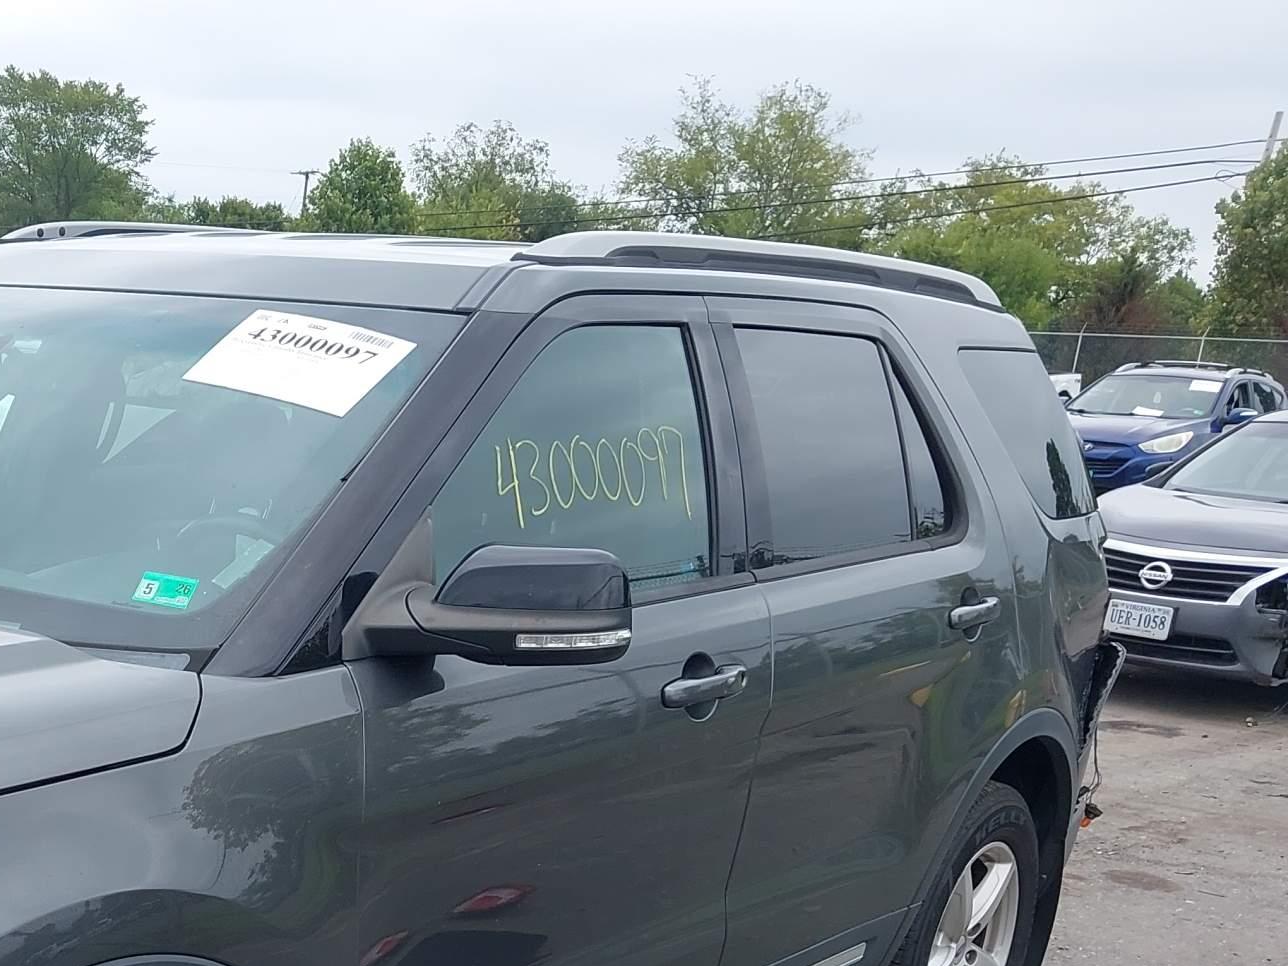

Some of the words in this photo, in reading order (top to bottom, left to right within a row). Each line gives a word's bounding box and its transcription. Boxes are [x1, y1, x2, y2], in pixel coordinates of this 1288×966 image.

[247, 327, 379, 365] 43000097
[494, 425, 692, 529] 43000097
[142, 582, 156, 595] 5
[175, 583, 192, 595] 26
[1110, 608, 1168, 631] UER-1058
